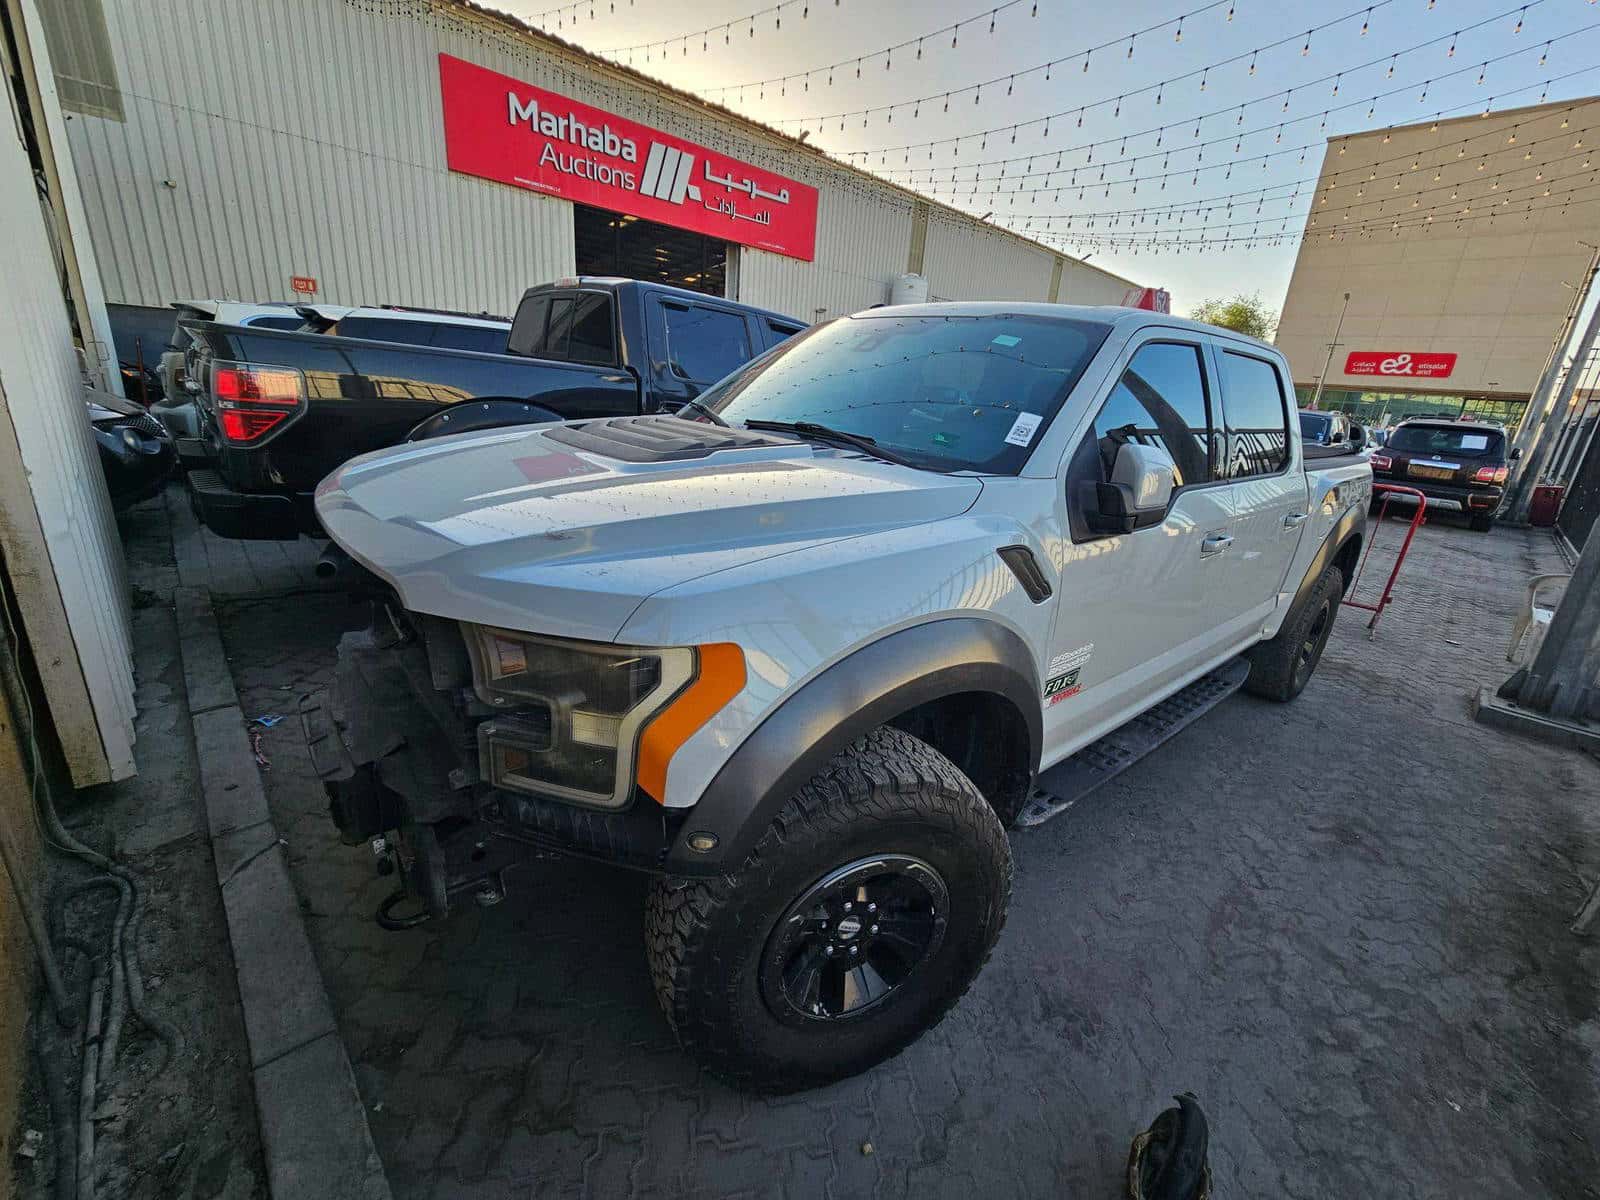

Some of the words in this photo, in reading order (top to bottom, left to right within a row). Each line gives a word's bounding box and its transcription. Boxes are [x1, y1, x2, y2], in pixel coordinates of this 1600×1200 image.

[507, 91, 637, 163] Marhaba
[539, 142, 636, 191] Auctions
[704, 159, 790, 205] مرحبا
